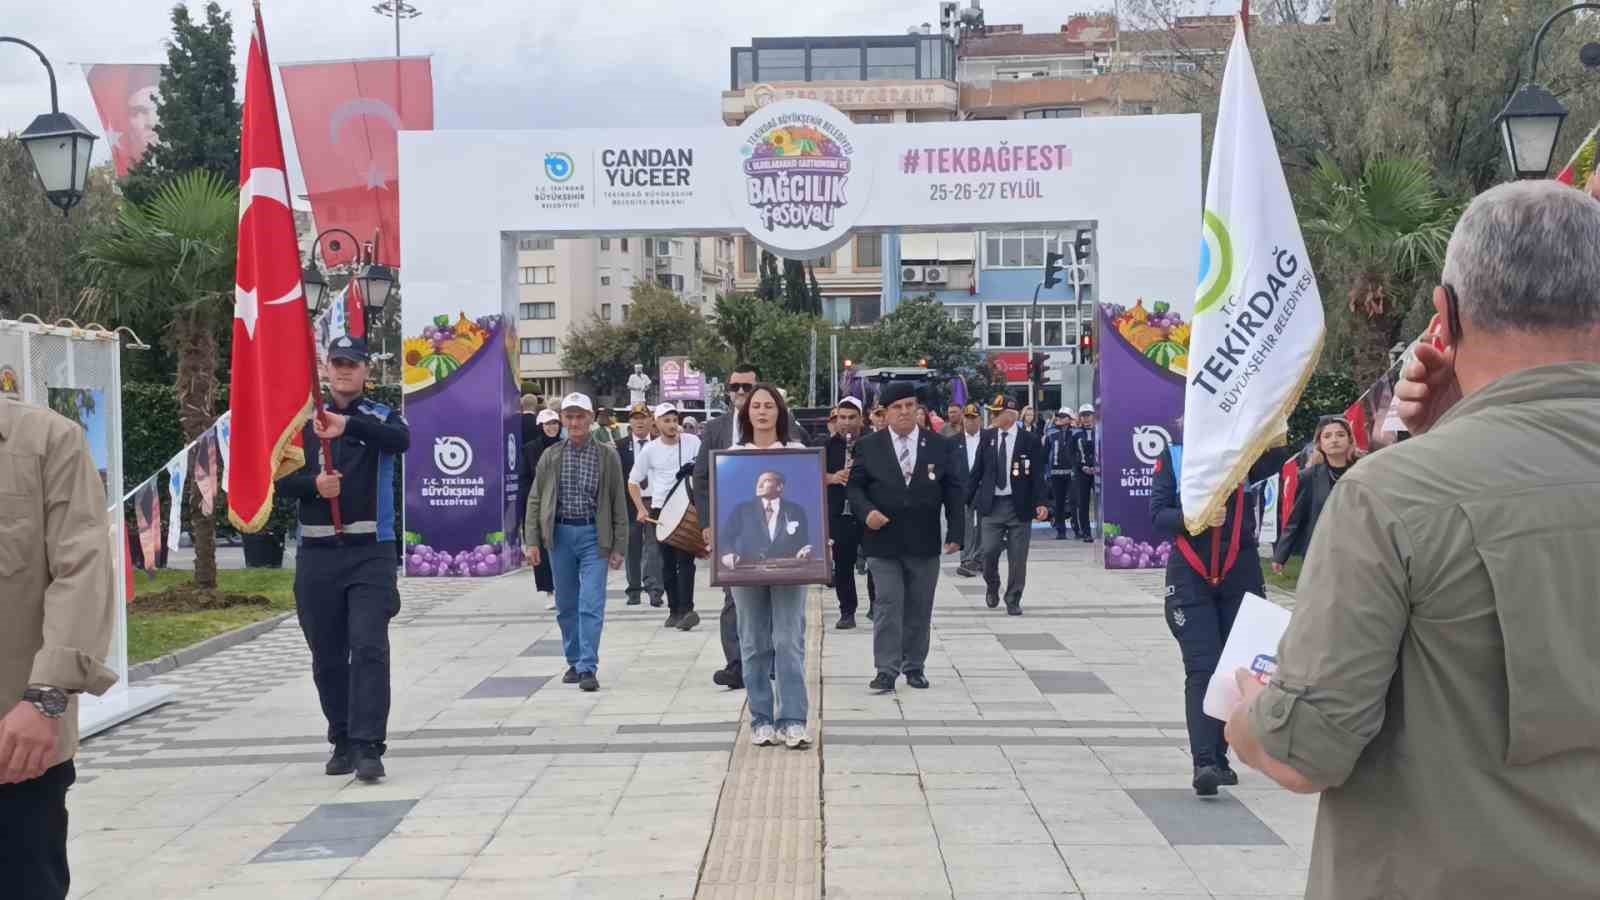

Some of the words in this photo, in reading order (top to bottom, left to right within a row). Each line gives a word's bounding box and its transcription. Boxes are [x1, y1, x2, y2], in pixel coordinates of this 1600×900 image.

[602, 148, 693, 168] CANDAN
[903, 140, 1067, 174] #TEKBAĞFEST
[749, 171, 848, 204] BAĞCILIK
[930, 182, 995, 201] 25-26-27
[1000, 178, 1043, 199] EYLÜL
[1192, 246, 1298, 395] TEKİRDAĞ
[1219, 333, 1278, 413] BÜYÜKŞEHİR
[1273, 270, 1313, 335] BELEDİYESİ
[421, 486, 485, 498] BÜYÜKŞEHİR
[441, 476, 484, 485] TEKİRDAĞ
[429, 498, 478, 506] BELEDİYESİ
